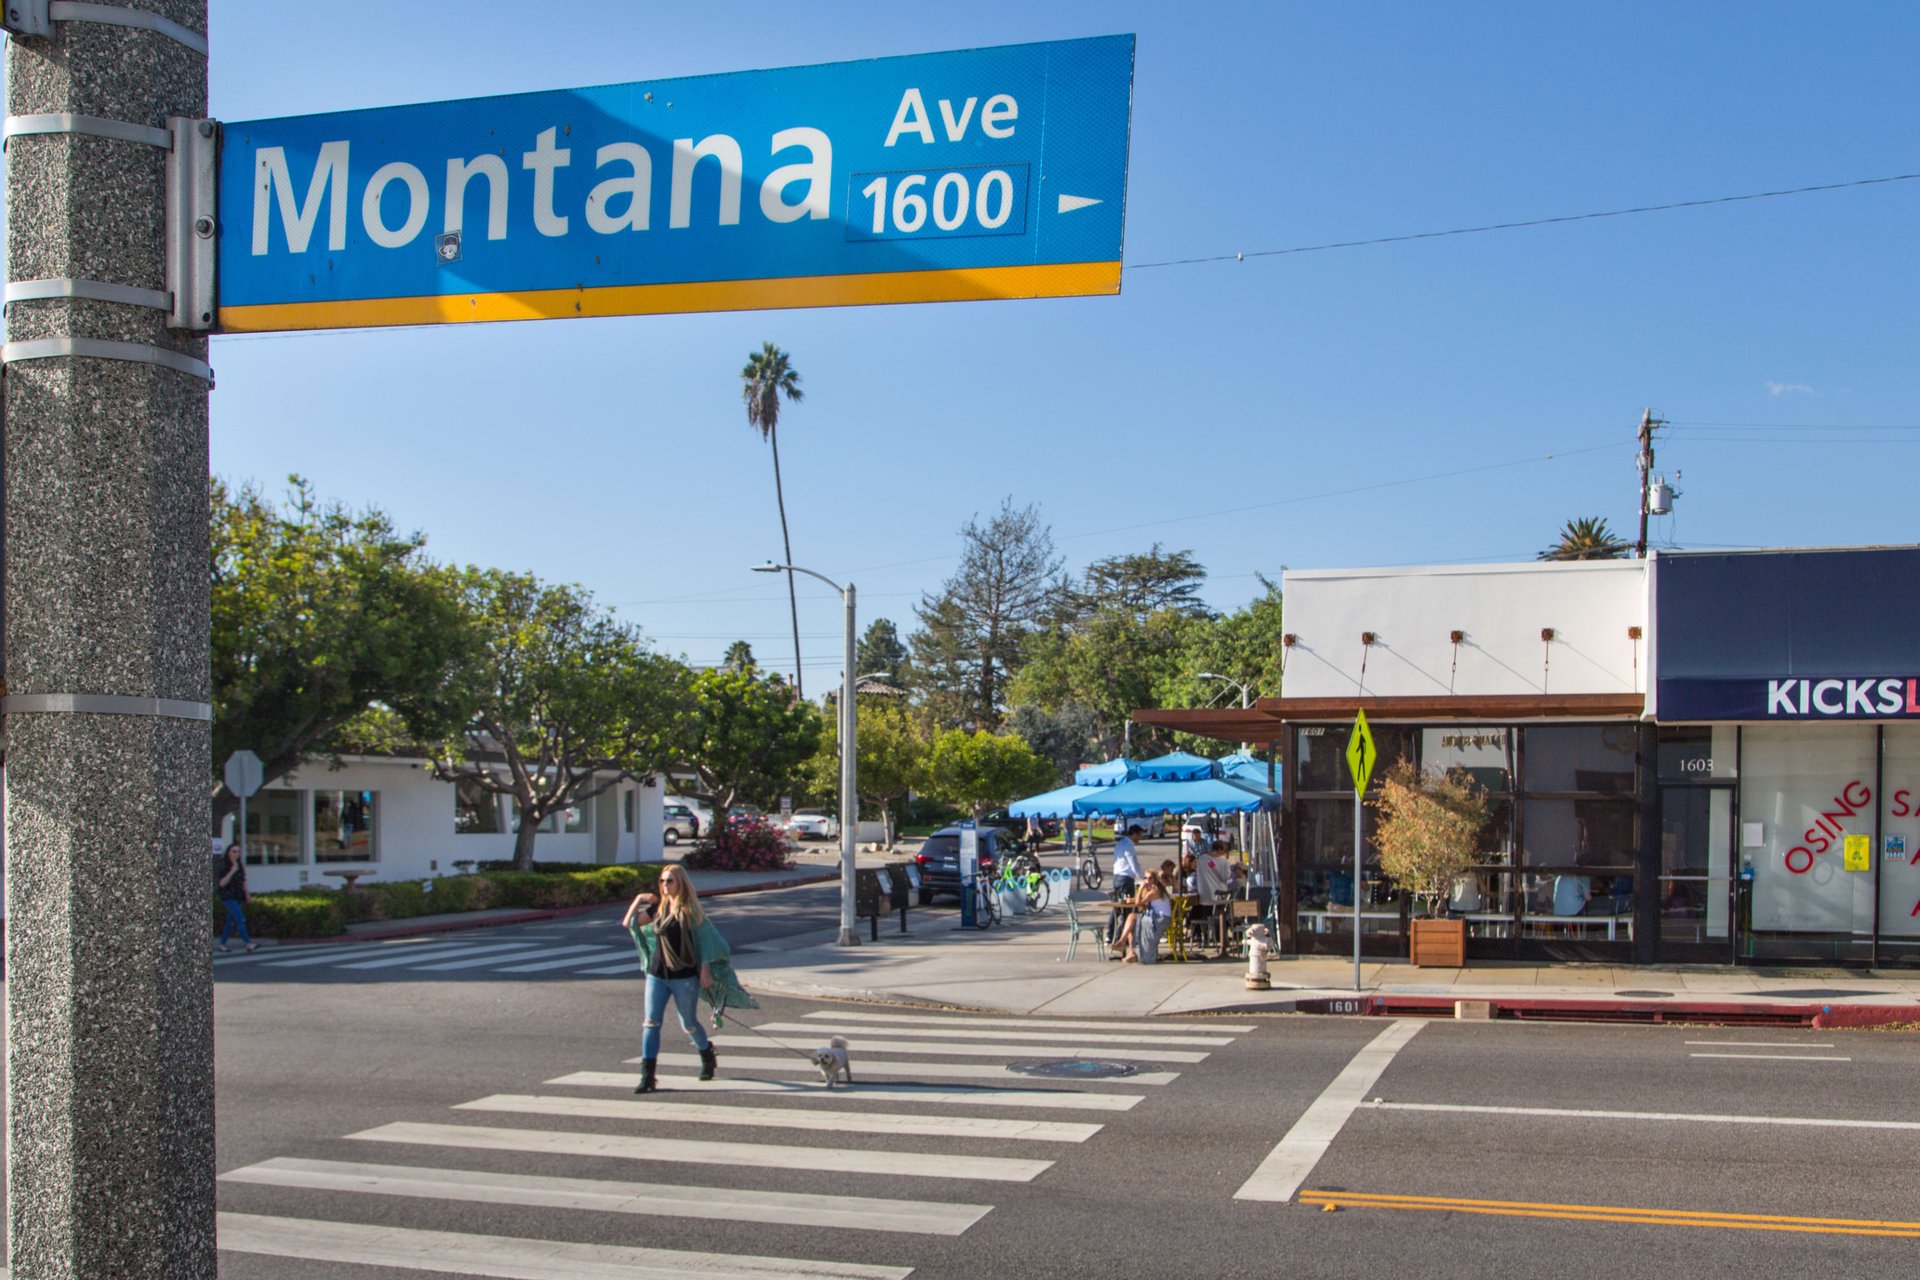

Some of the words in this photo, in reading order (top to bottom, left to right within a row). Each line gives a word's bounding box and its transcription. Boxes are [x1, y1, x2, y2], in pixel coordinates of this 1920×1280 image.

[883, 87, 1019, 147] Ave
[252, 126, 833, 256] Montana
[862, 170, 1014, 234] 1600
[1680, 758, 1714, 772] 1603
[1891, 789, 1920, 817] S
[1329, 1000, 1359, 1013] 1601
